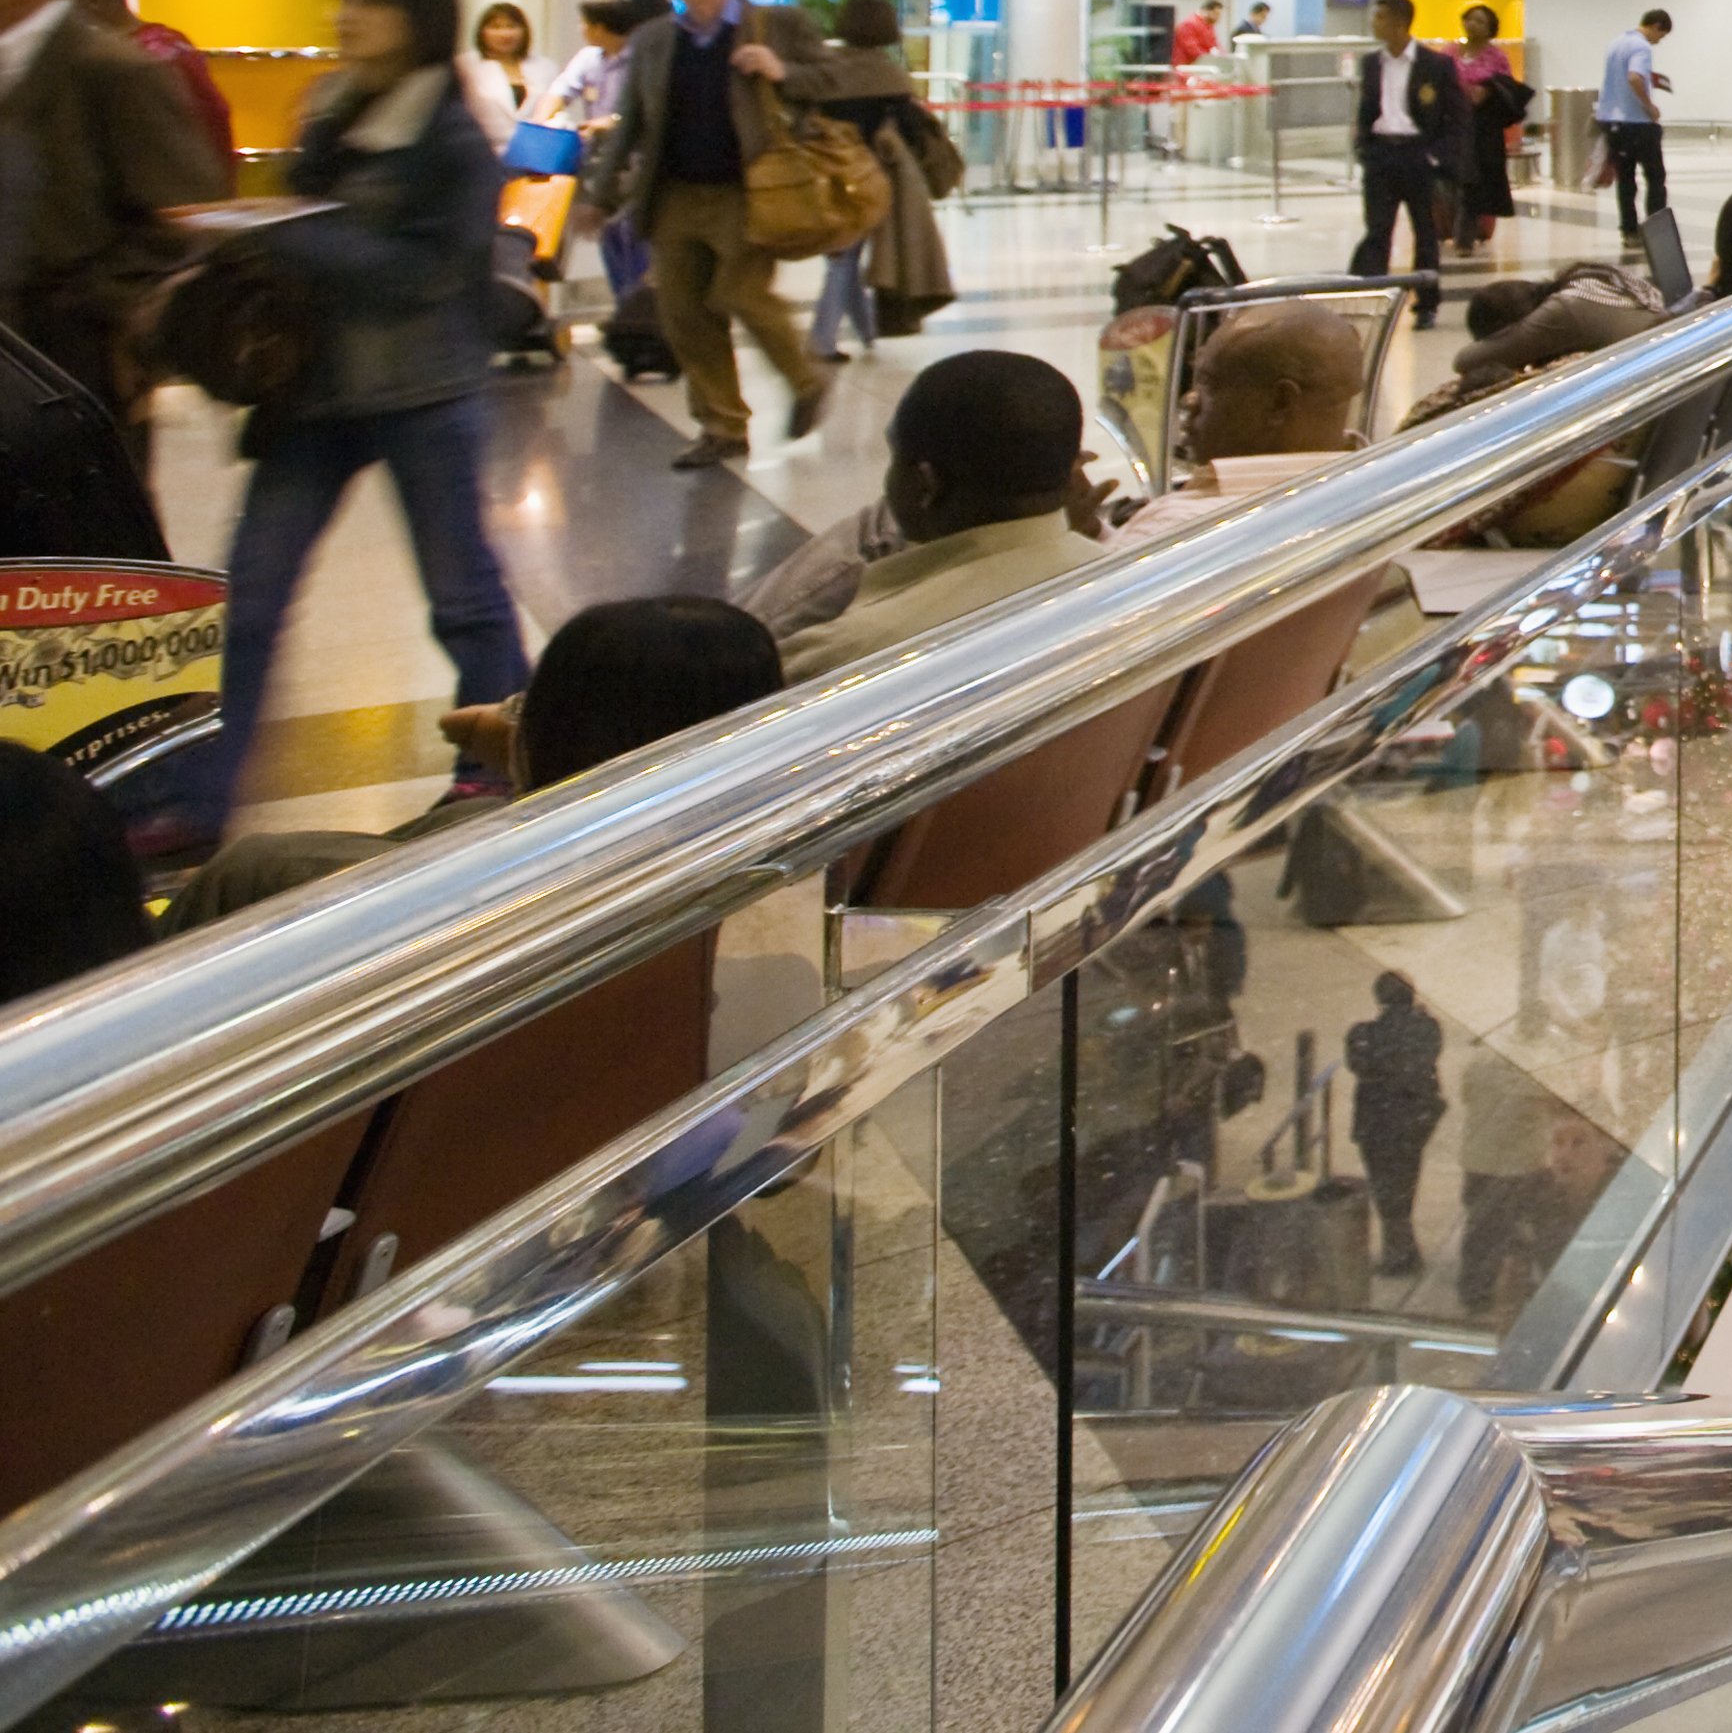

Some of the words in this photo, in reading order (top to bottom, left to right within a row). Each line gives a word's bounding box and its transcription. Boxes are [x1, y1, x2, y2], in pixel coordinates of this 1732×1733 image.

[16, 586, 90, 615] Duty
[95, 583, 159, 608] Free
[65, 710, 171, 767] rprises.
